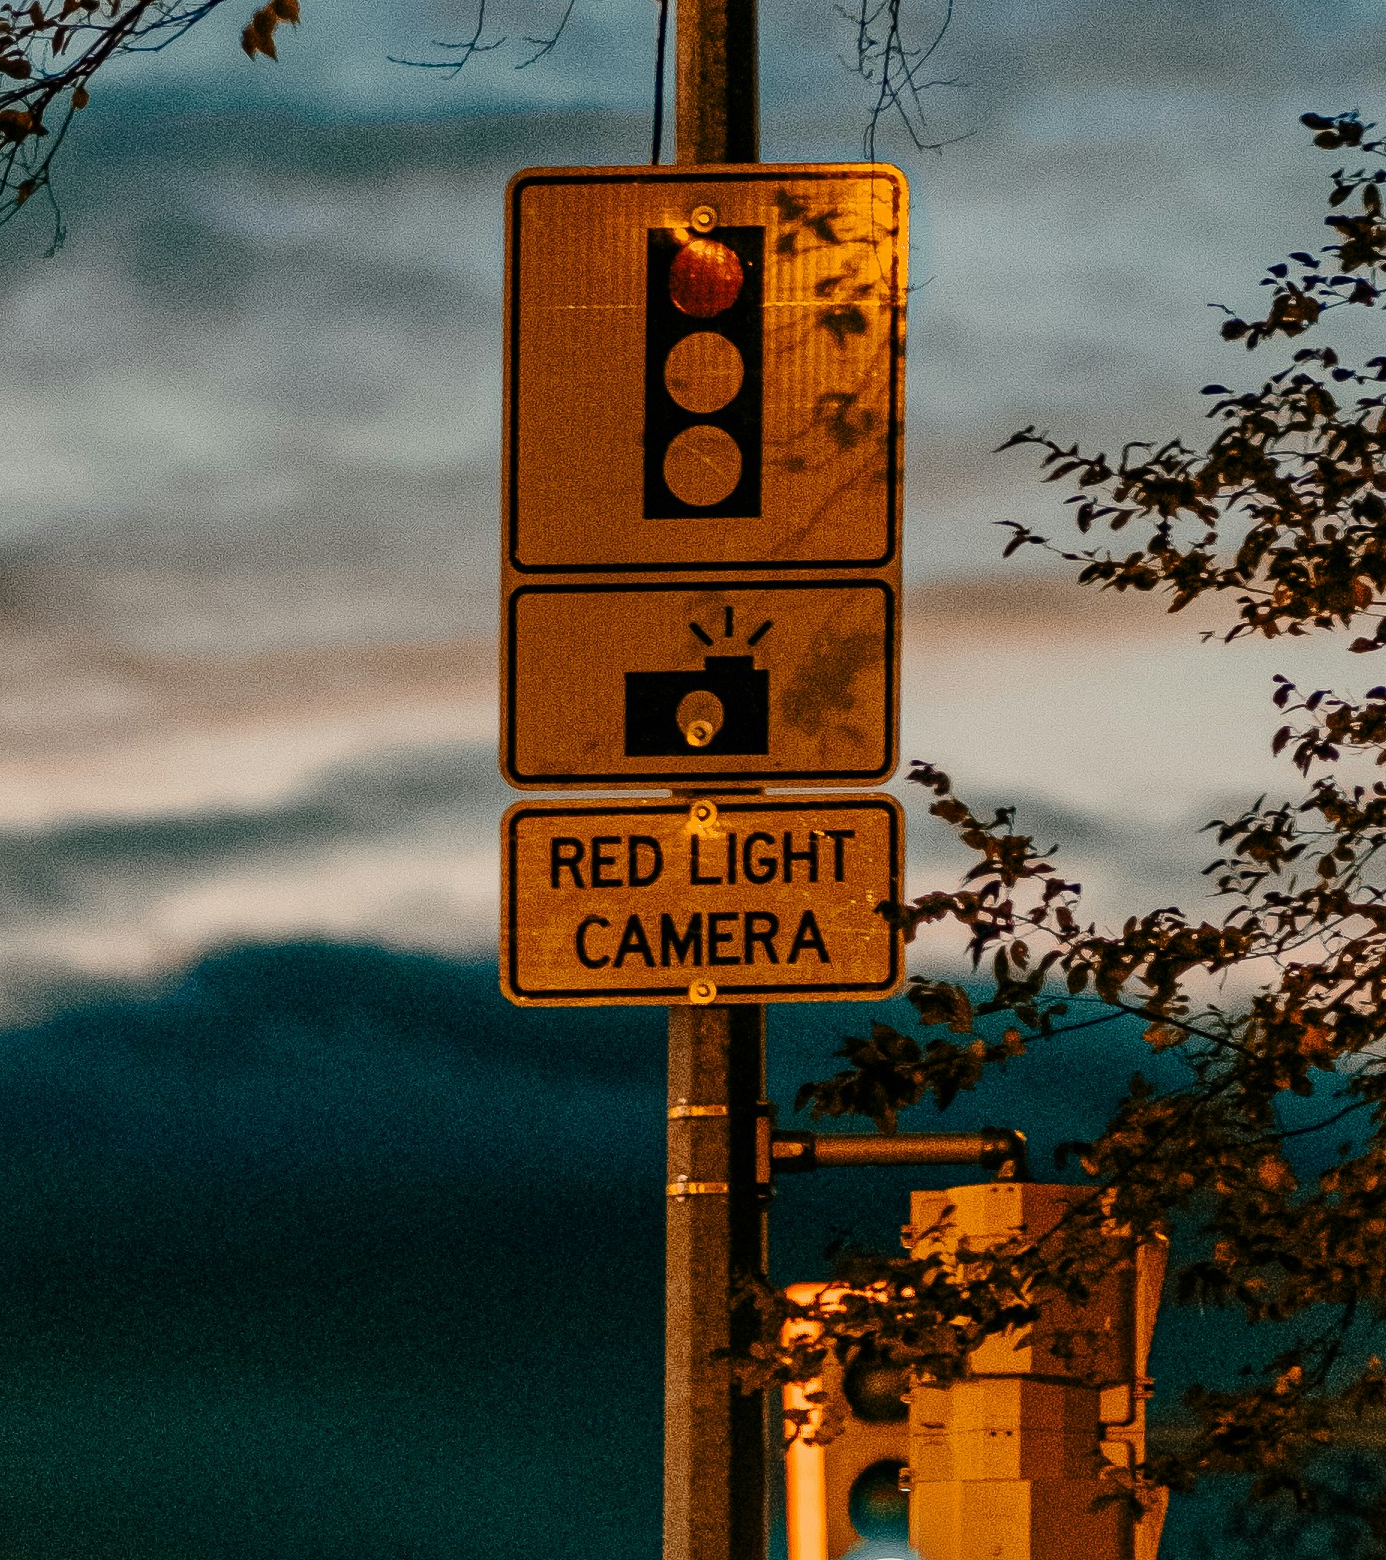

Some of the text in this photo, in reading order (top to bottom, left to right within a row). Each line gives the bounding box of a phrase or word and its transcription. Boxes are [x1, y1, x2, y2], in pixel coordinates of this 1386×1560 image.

[550, 829, 856, 889] RED LIGHT
[574, 910, 831, 970] CAMERA
